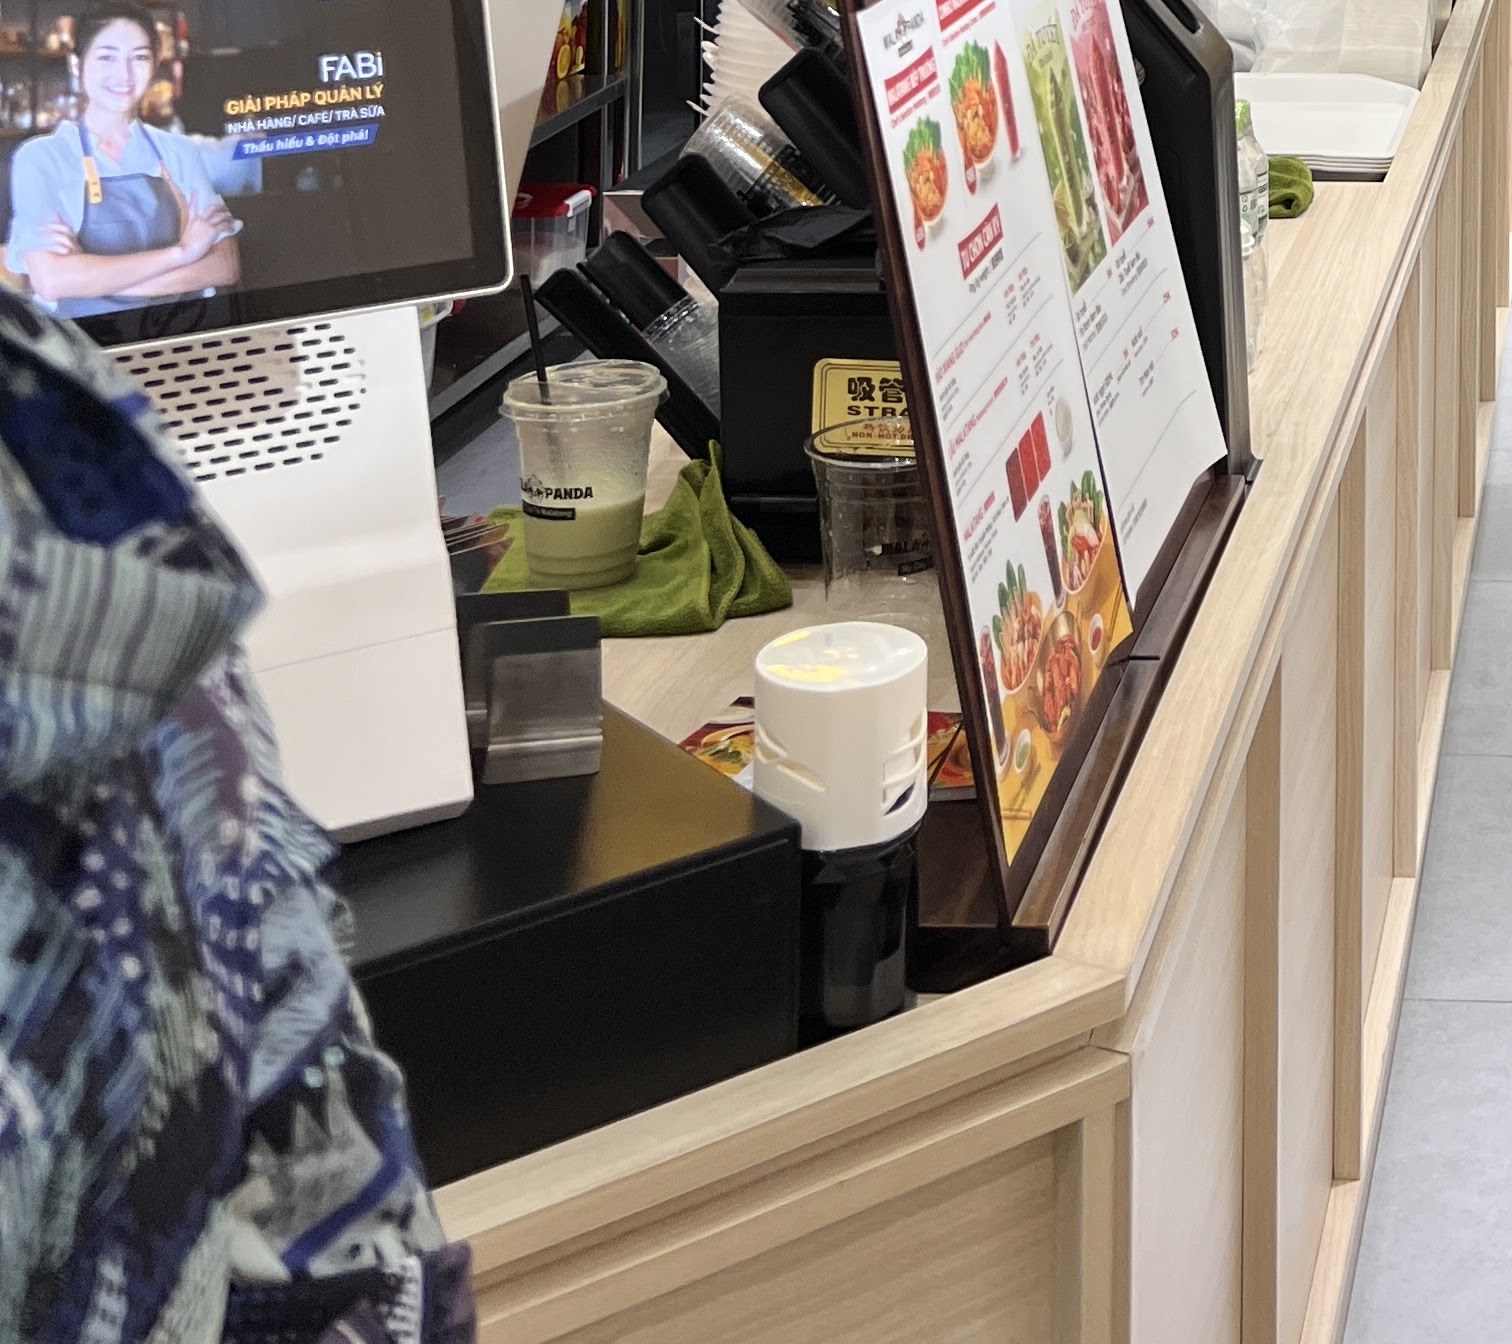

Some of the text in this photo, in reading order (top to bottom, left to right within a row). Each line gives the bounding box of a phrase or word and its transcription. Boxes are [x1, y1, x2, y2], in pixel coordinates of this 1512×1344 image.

[265, 90, 311, 111] PHÁP
[365, 81, 384, 99] LÝ
[305, 135, 315, 147] &
[544, 486, 594, 500] PANDA
